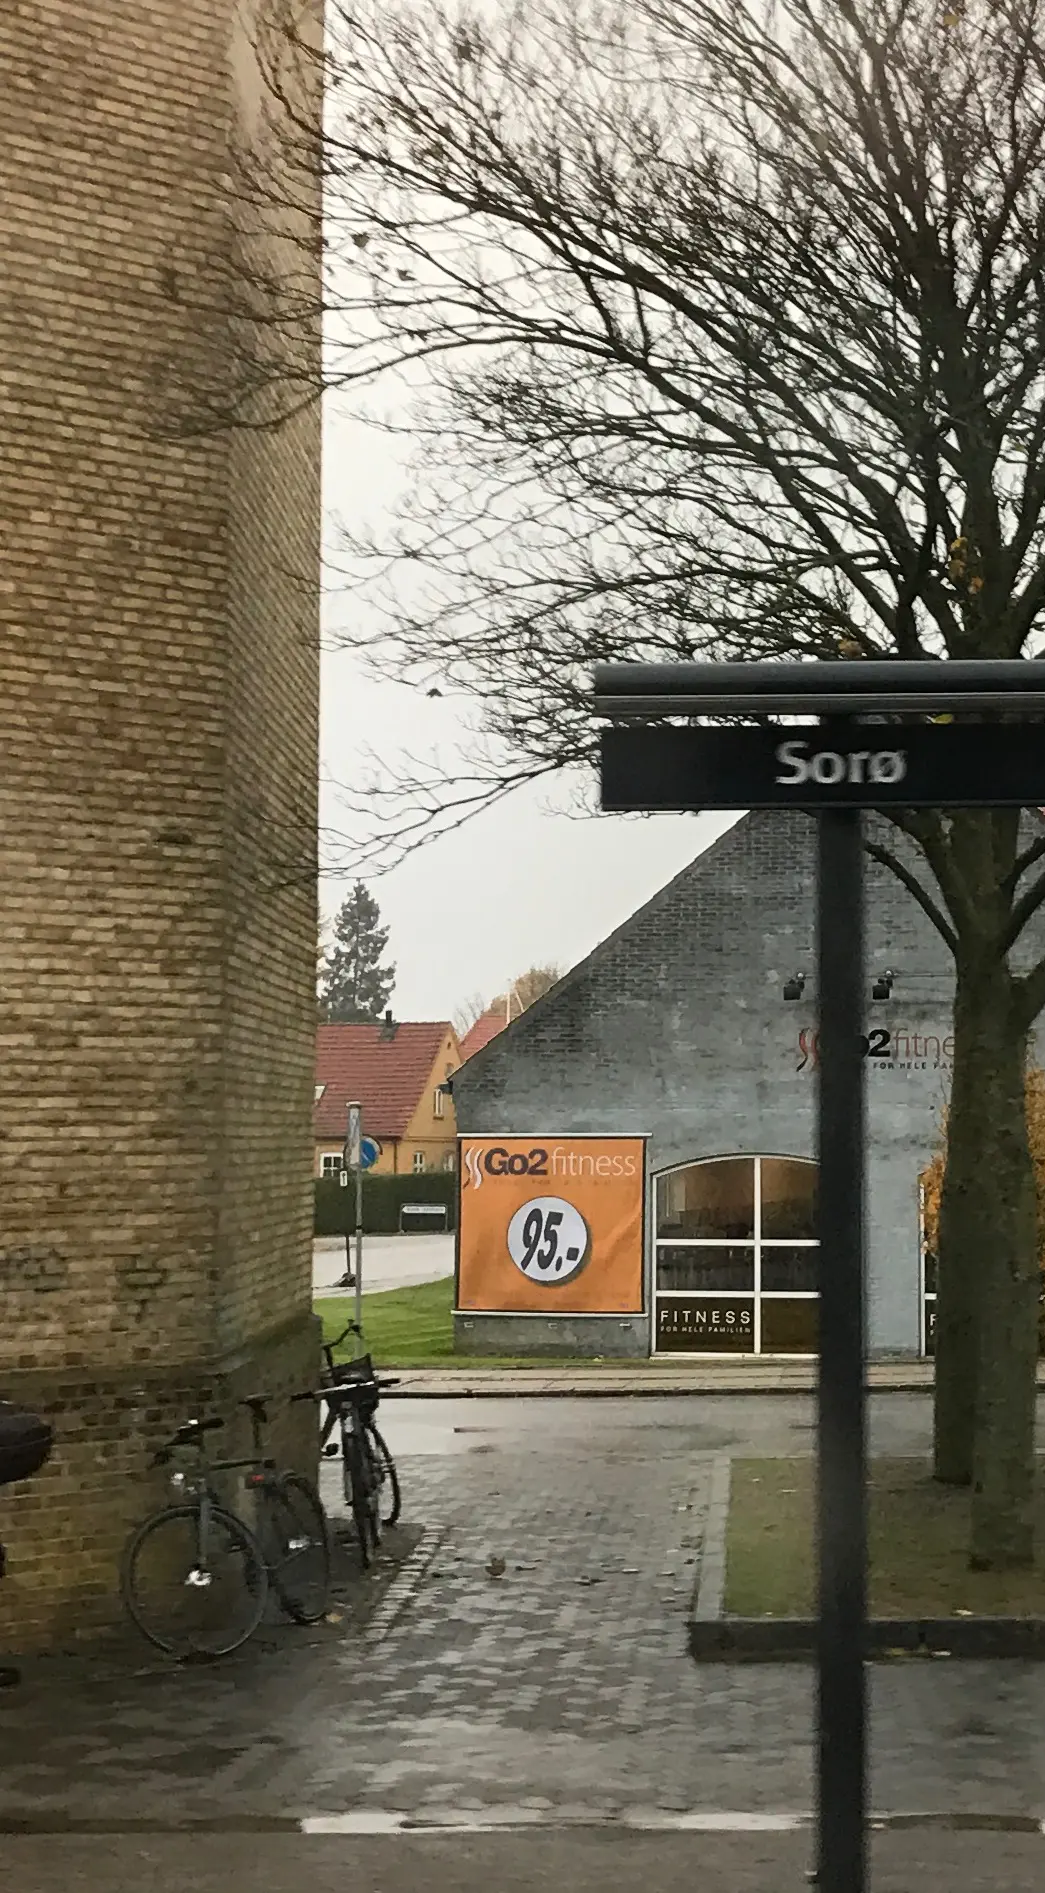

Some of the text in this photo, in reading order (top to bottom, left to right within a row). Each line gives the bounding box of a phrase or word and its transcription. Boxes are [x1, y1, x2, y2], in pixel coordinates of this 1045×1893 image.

[775, 740, 906, 784] Sorø
[521, 1208, 580, 1272] 95.-
[660, 1310, 751, 1324] FITNESS
